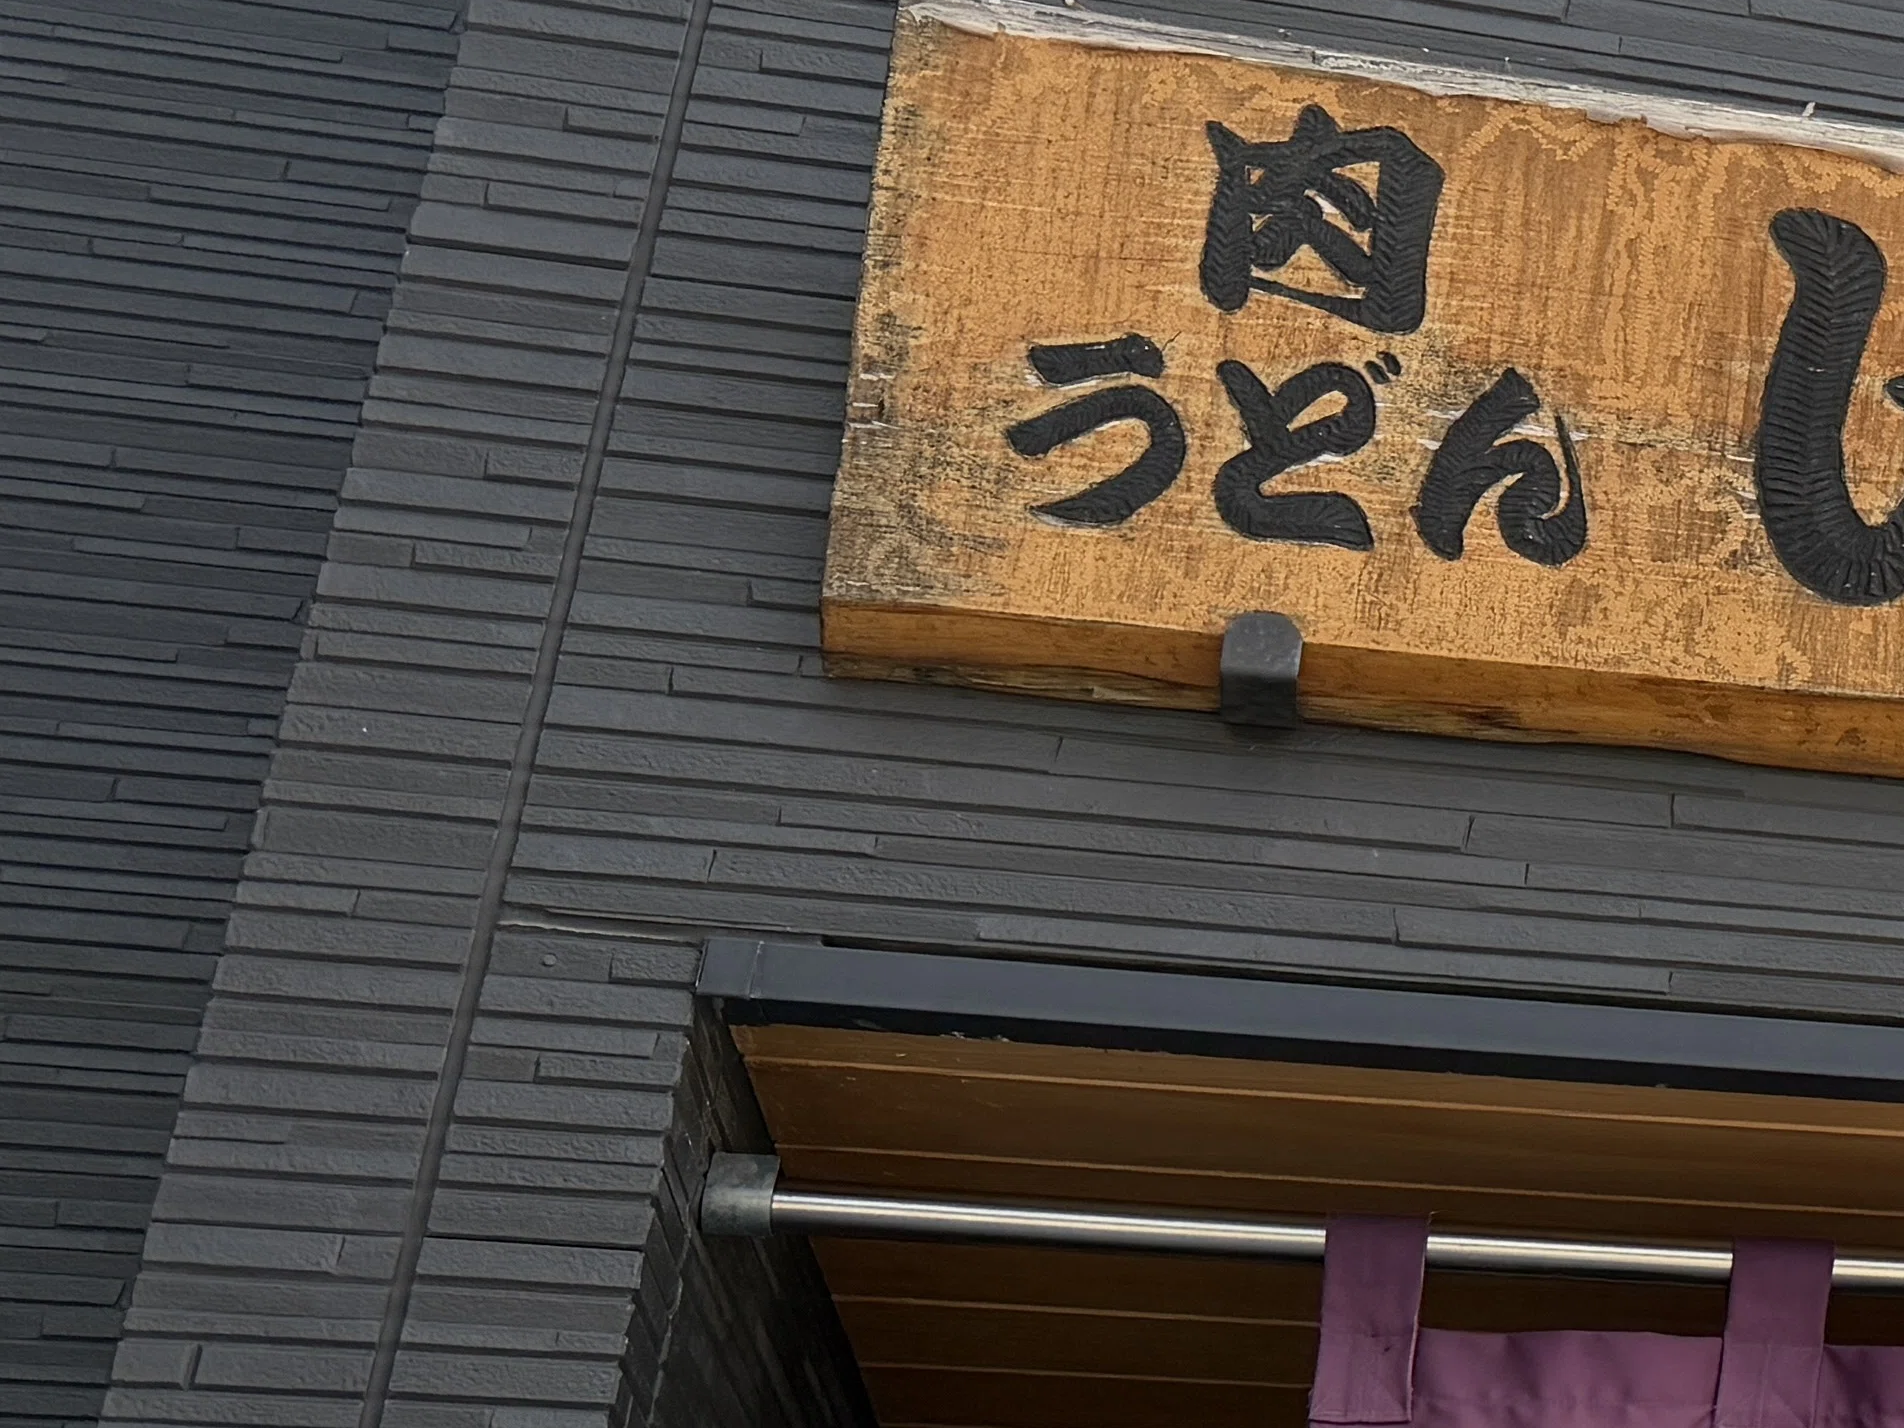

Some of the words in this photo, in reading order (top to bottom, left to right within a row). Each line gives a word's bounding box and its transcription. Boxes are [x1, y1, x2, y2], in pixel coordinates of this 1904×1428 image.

[1200, 105, 1446, 335] 肉
[1006, 332, 1588, 568] うどん
